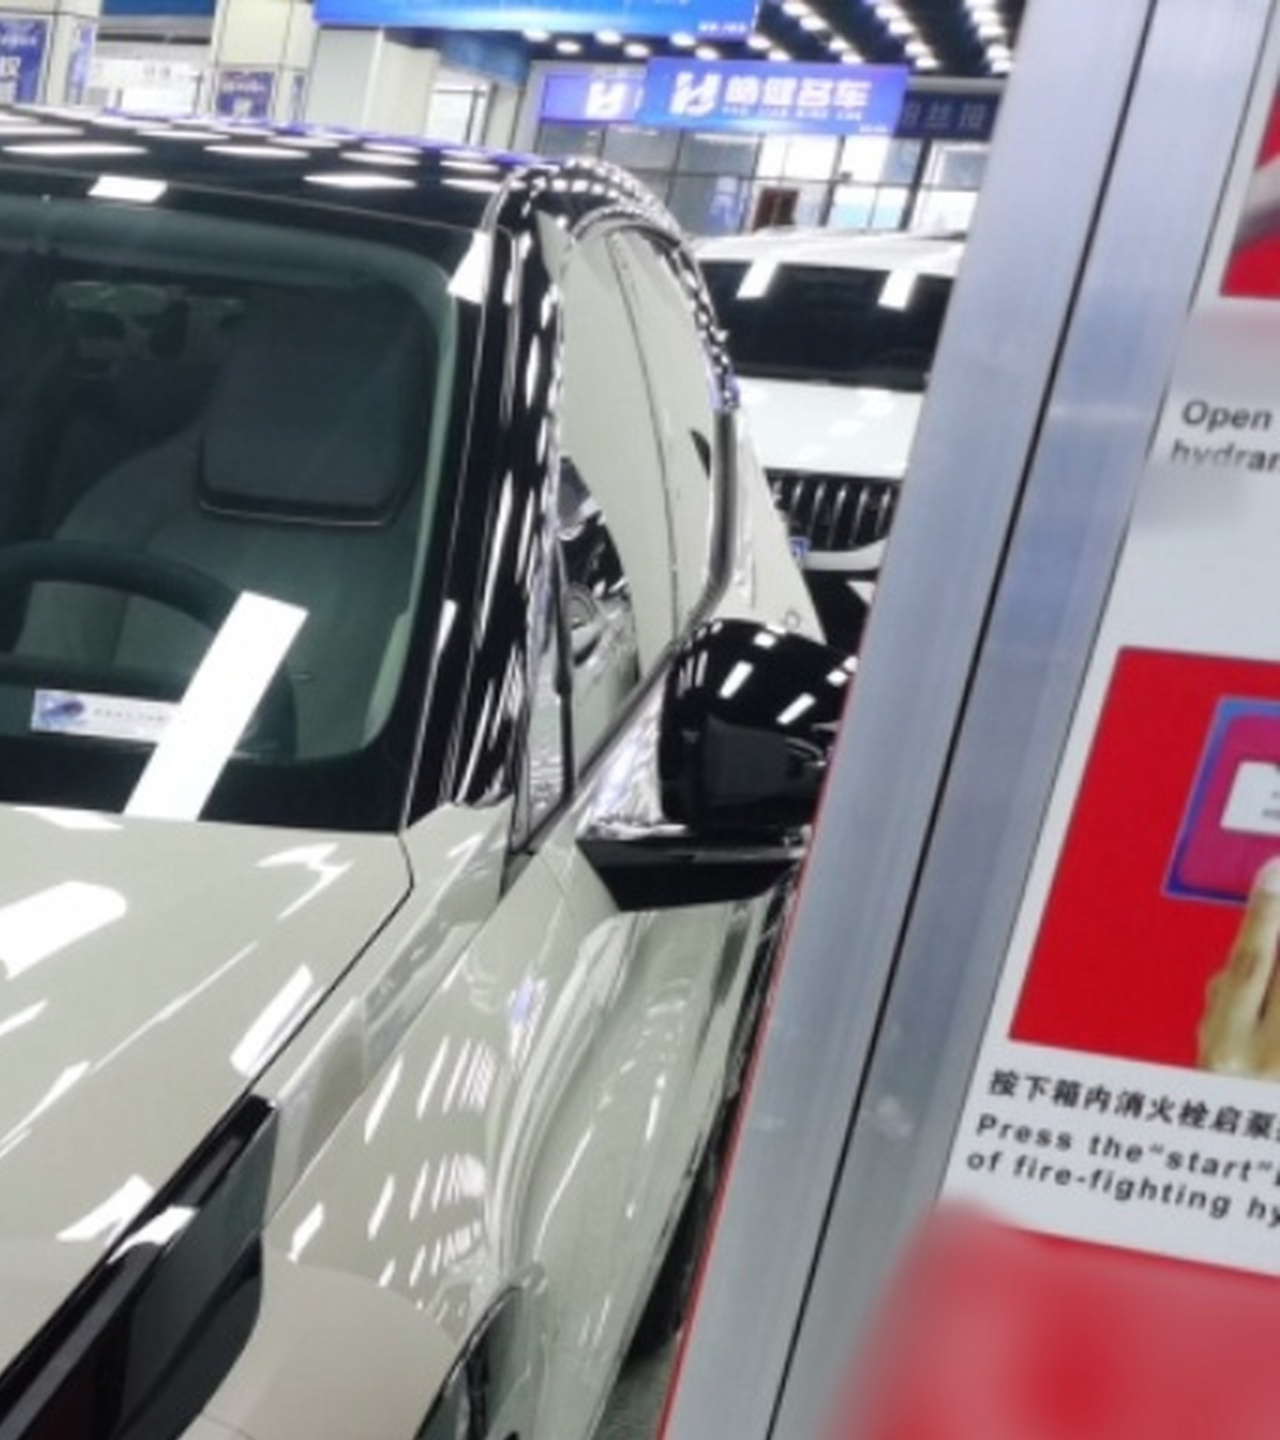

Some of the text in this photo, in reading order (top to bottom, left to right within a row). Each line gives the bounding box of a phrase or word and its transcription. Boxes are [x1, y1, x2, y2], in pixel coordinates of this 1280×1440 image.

[1182, 400, 1272, 434] Open
[977, 1113, 1072, 1151] Press
[990, 1069, 1280, 1143] 按下箱内消火栓启泵
[966, 1150, 1002, 1171] of
[1014, 1154, 1231, 1219] fire-fighting
